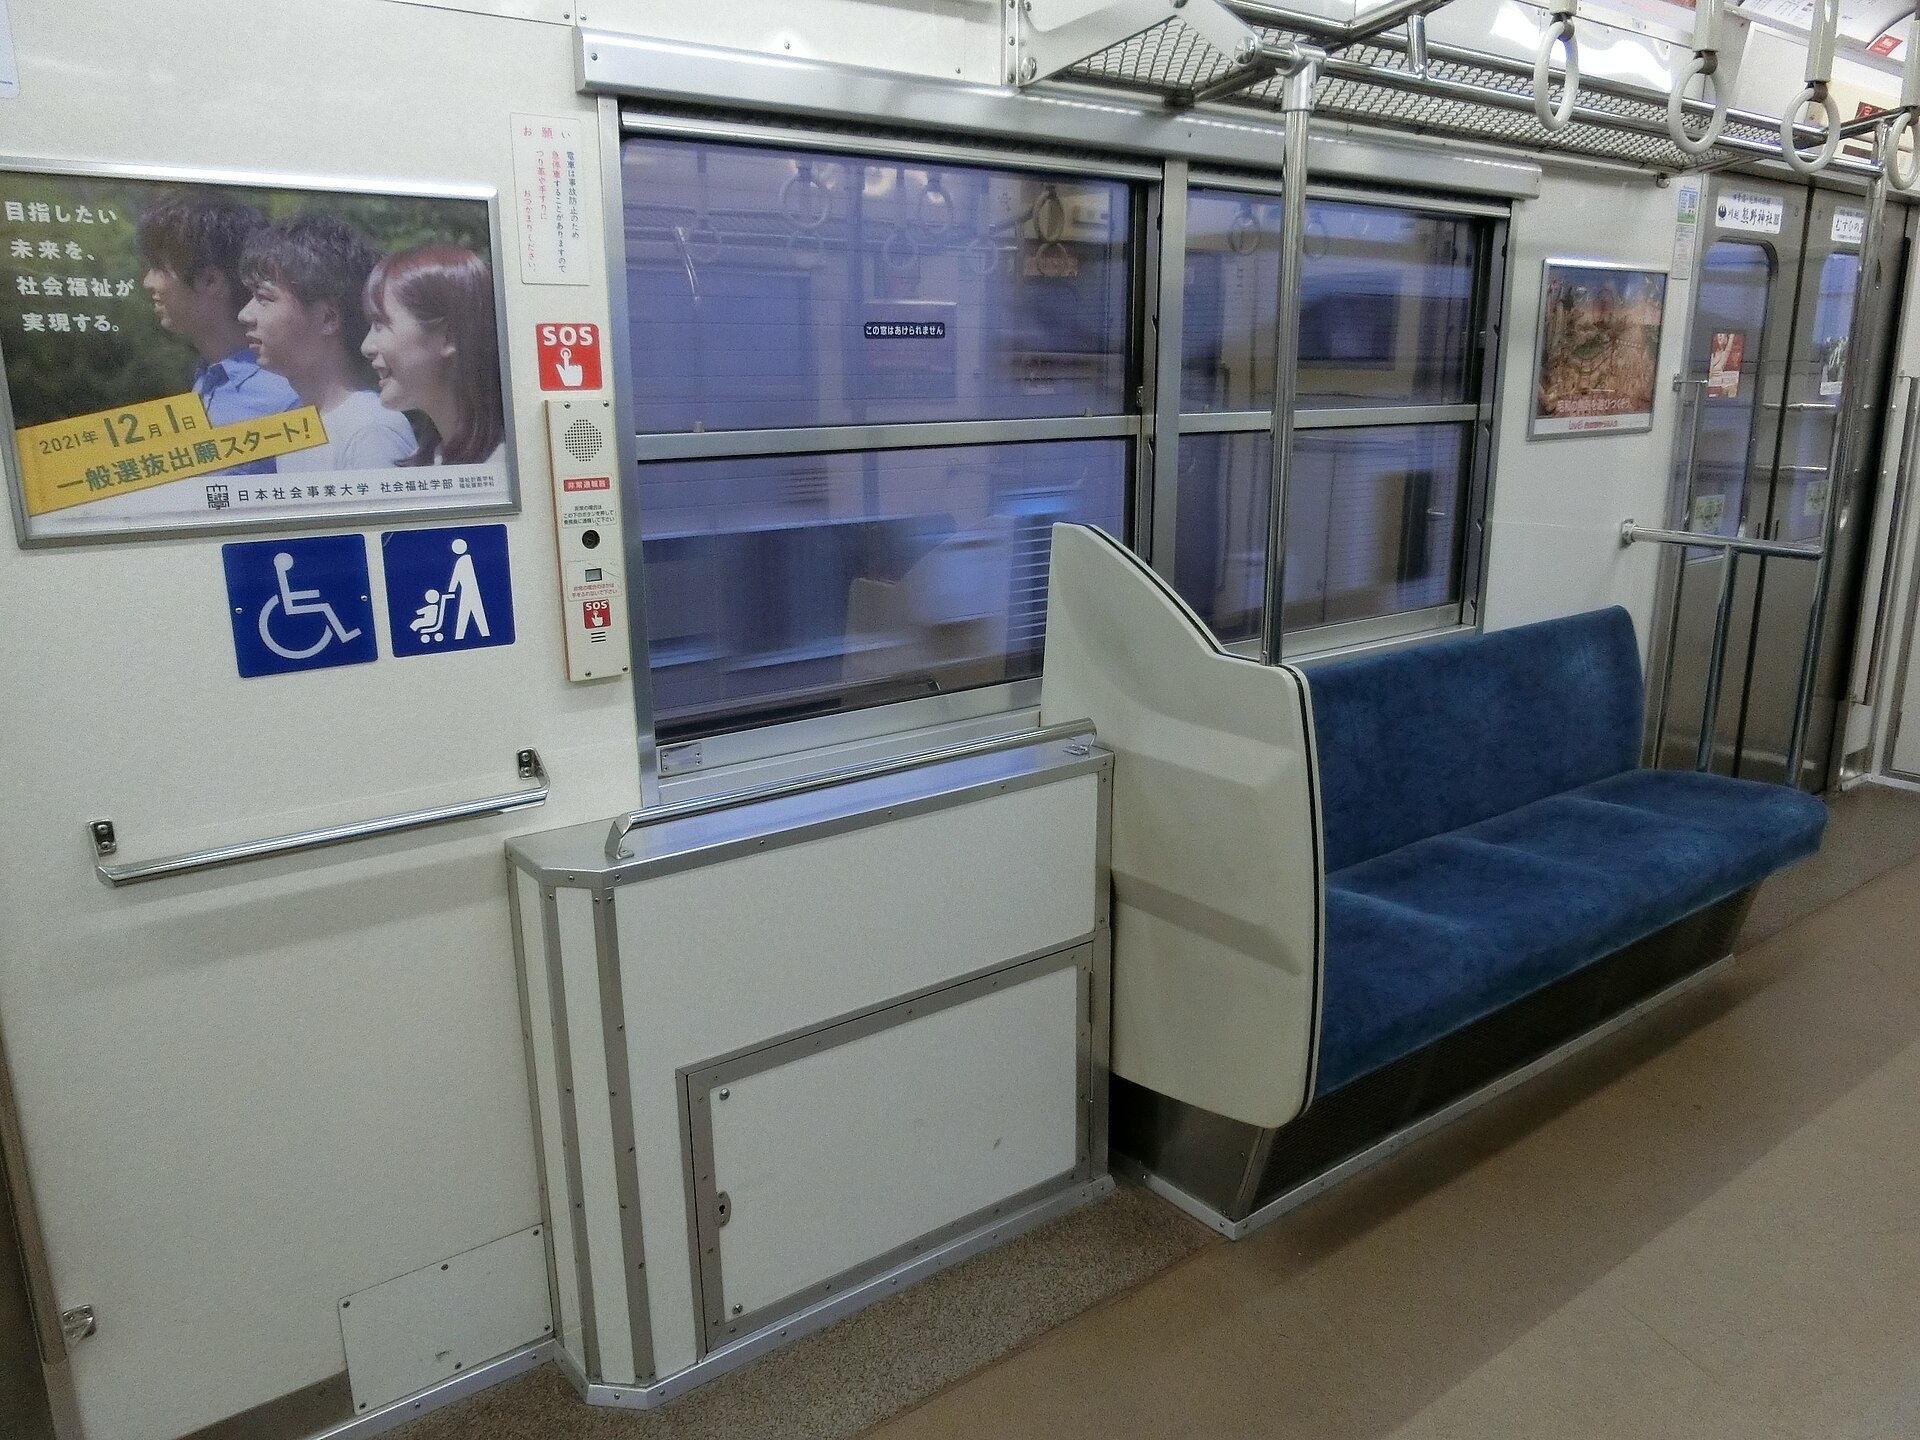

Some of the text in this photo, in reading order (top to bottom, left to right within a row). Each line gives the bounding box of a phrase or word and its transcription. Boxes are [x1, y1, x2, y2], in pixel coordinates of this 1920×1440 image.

[523, 126, 571, 139] お願い
[566, 151, 580, 239] 電車は事故防止のため
[5, 201, 117, 224] 目指したい
[552, 151, 567, 273] 急停車することがありますので
[11, 238, 95, 260] 未来を、
[16, 275, 135, 297] 社会福祉が
[22, 312, 119, 332] 実現する。
[866, 325, 944, 336] この窓はあけられません
[543, 326, 593, 346] SOS
[238, 478, 453, 502] 日本社会事業大学 社会福祉学部
[585, 601, 608, 611] SOS
